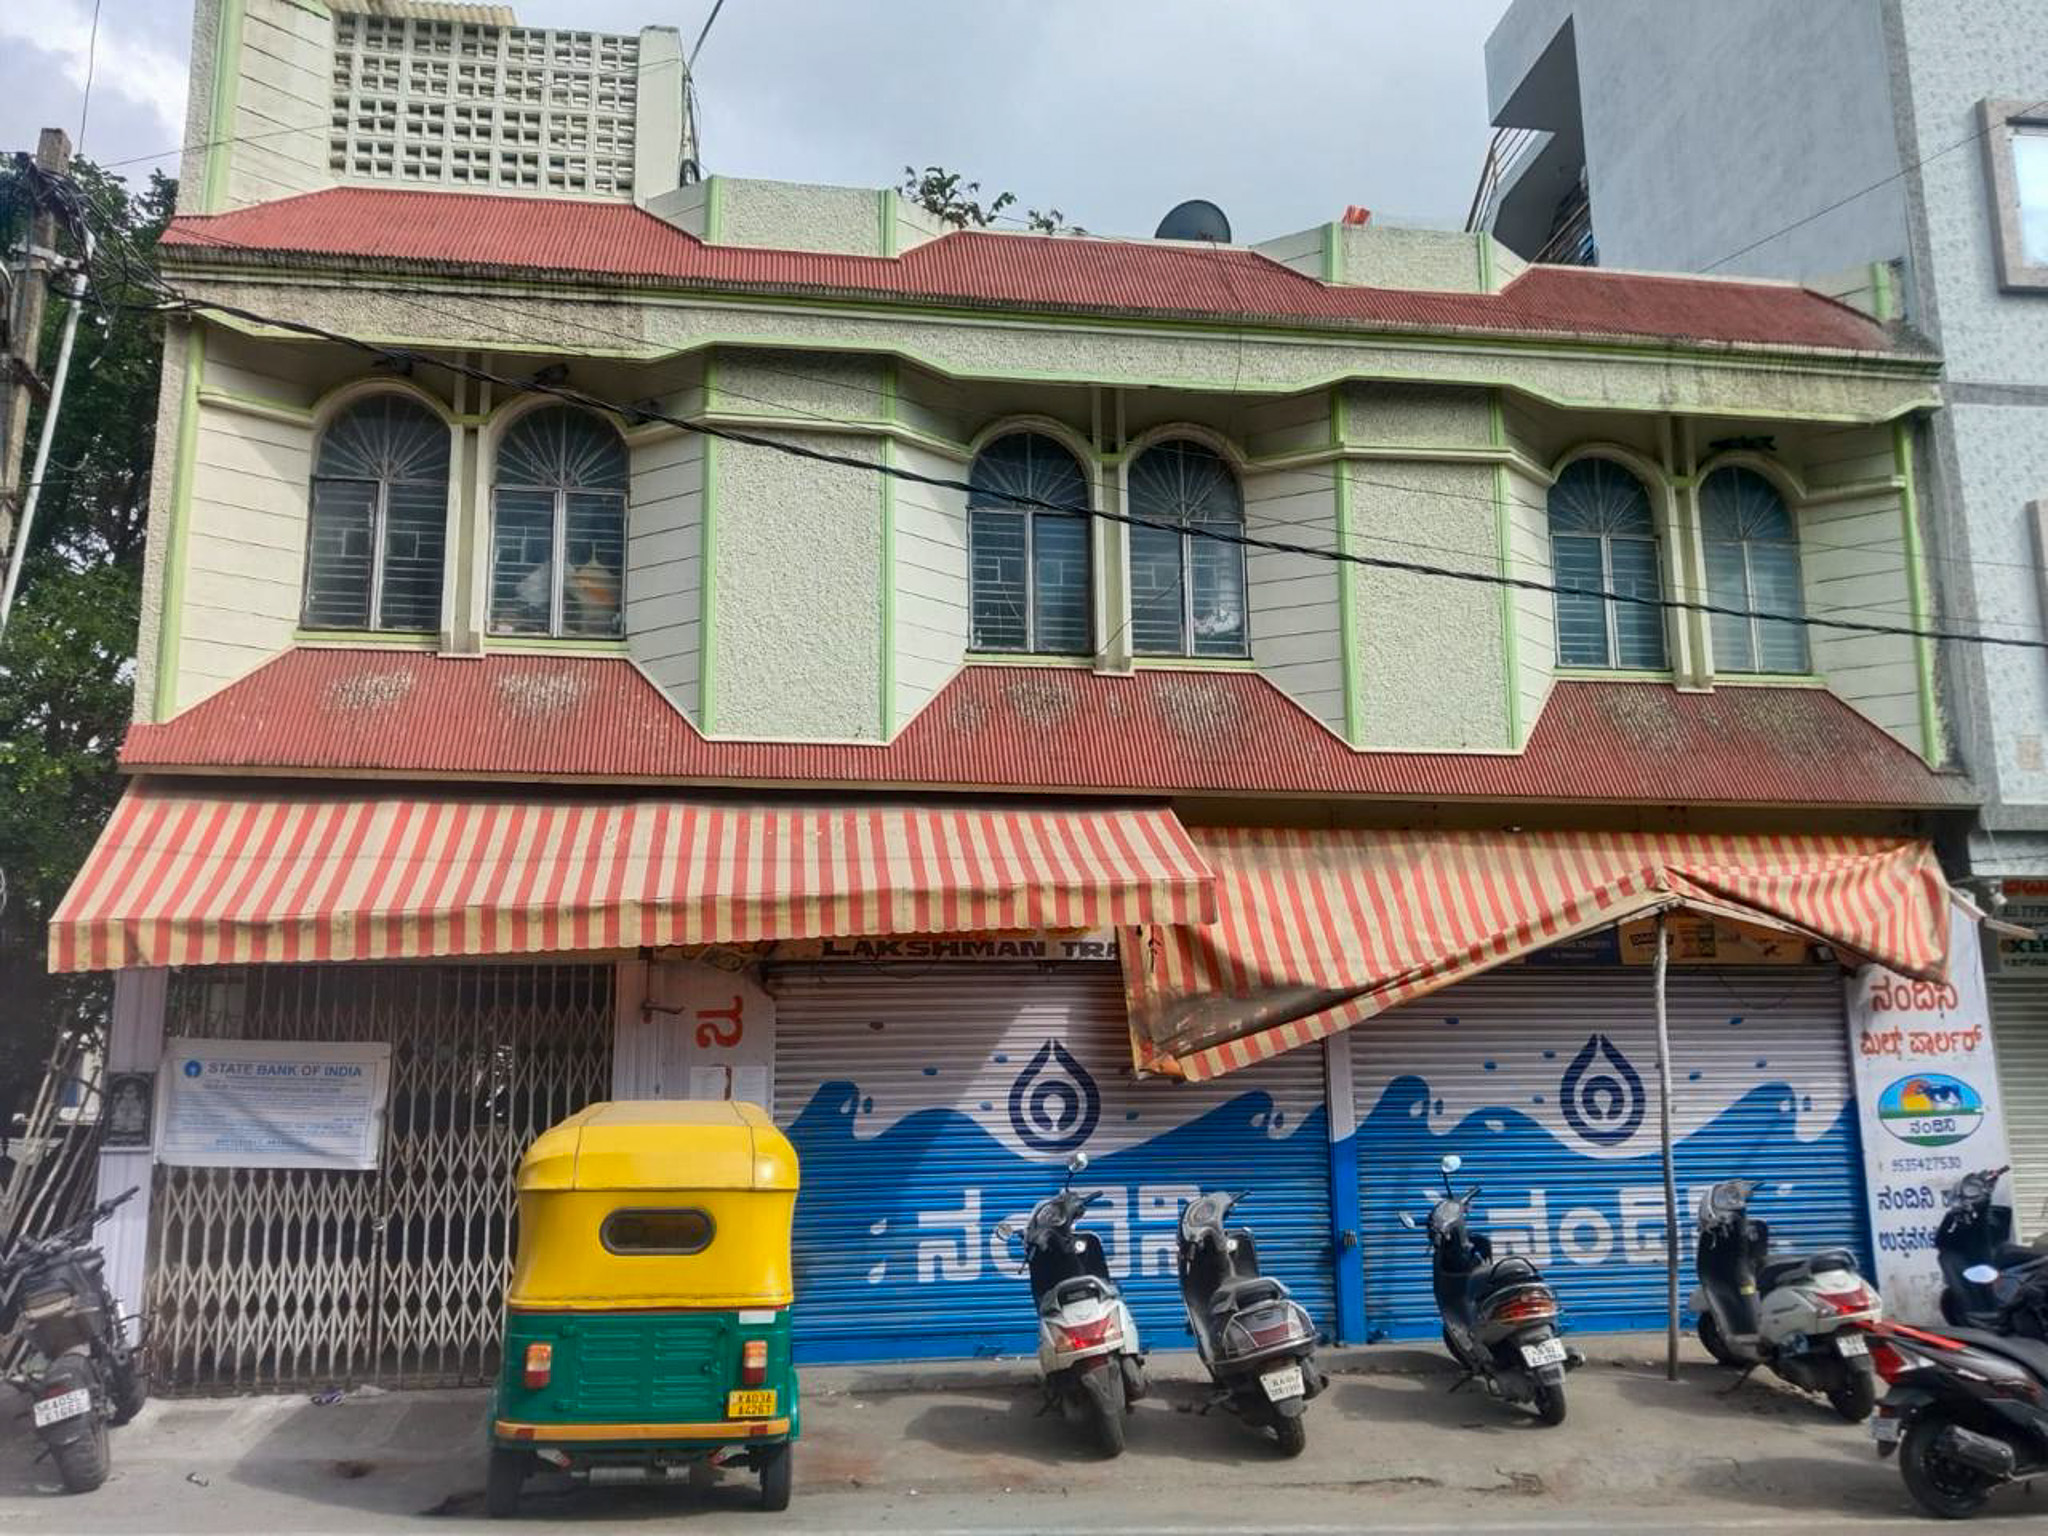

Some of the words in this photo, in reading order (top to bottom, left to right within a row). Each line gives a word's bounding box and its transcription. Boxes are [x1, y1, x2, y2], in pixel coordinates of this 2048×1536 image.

[821, 940, 1047, 958] LAKSHMAN
[1060, 941, 1118, 960] TRA
[1870, 976, 1958, 1012] ನಂದಿನಿ
[208, 1061, 252, 1075] STATE
[256, 1064, 298, 1077] BANK
[301, 1065, 320, 1077] OF
[324, 1065, 362, 1078] INDIA
[1877, 1185, 1935, 1211] ನಂದಿನಿ
